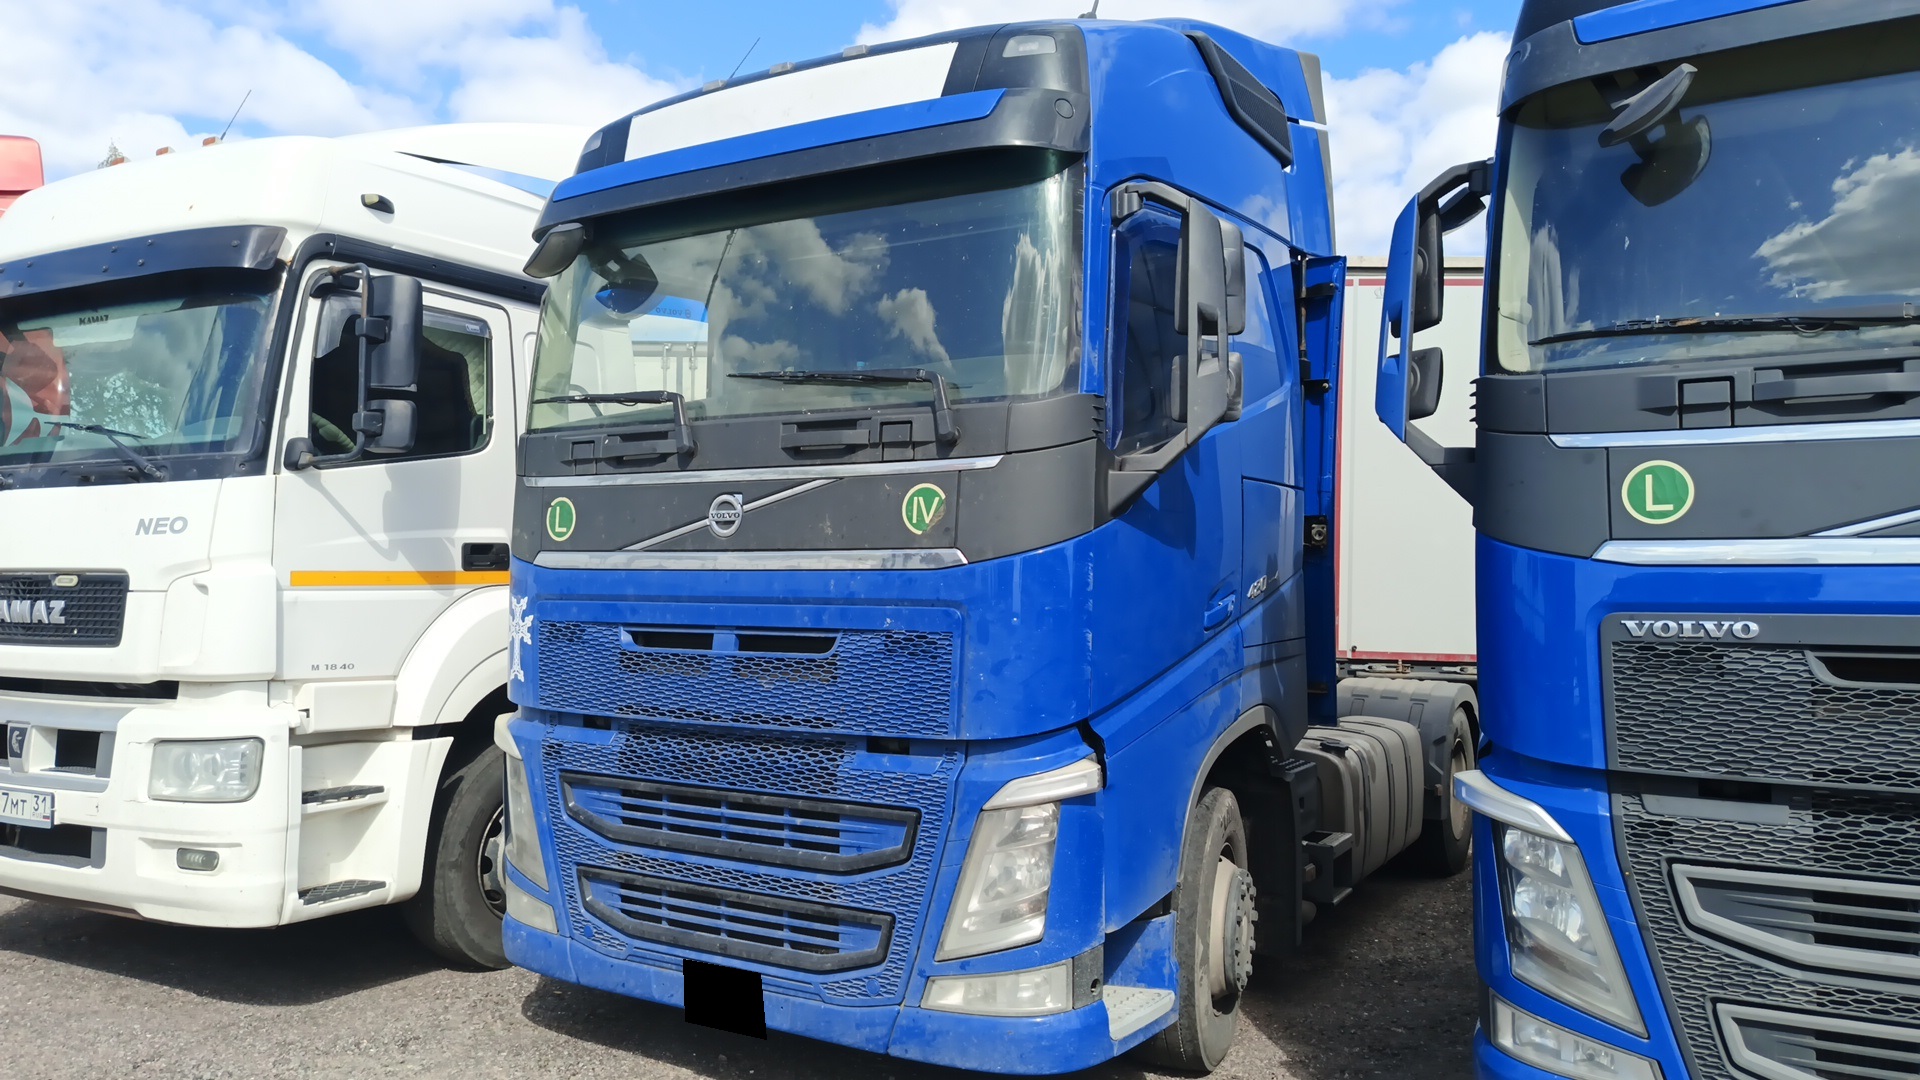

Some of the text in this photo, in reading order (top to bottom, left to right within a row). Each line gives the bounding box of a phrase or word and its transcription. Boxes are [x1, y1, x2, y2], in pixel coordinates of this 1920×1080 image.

[1645, 474, 1674, 511] L
[555, 506, 567, 532] L
[912, 496, 940, 524] IV
[135, 516, 188, 536] NEO
[1620, 620, 1760, 638] VOLVO
[33, 795, 47, 813] 31
